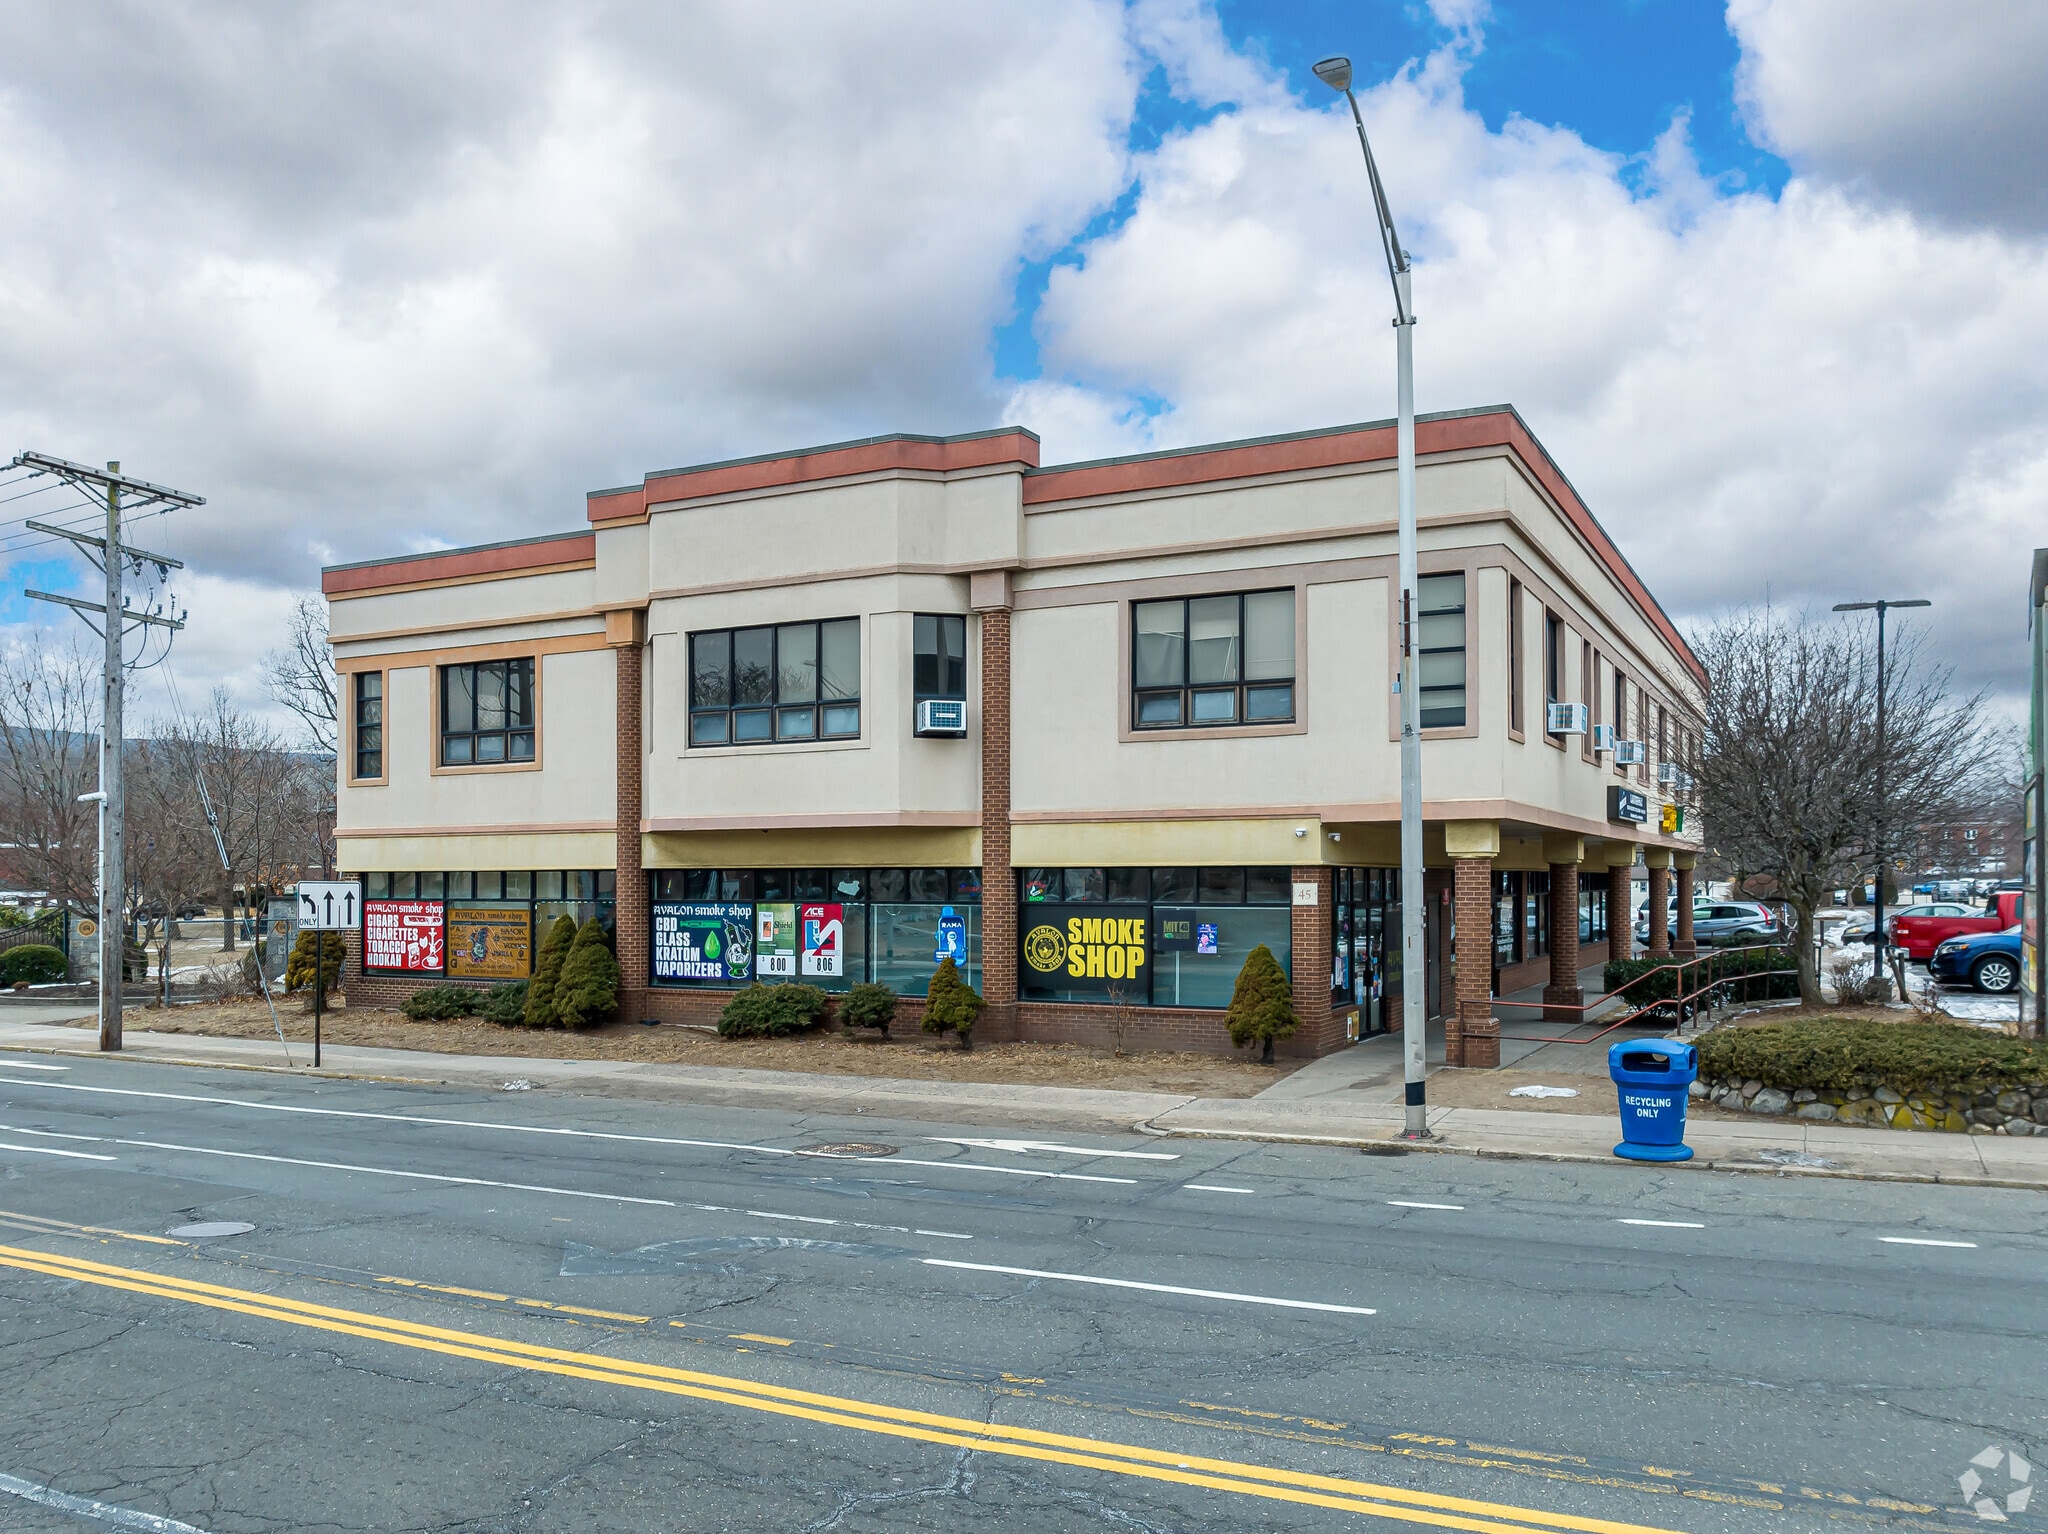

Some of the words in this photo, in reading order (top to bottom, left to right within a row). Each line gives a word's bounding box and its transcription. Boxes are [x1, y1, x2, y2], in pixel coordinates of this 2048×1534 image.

[1297, 889, 1311, 900] 45
[366, 904, 398, 913] AVALON
[398, 902, 423, 913] smoke
[425, 902, 444, 917] shop
[455, 911, 485, 920] AVALON
[653, 905, 693, 915] AVALON
[694, 903, 726, 916] smoke
[728, 903, 752, 920] shop
[804, 907, 824, 915] ACE
[300, 918, 317, 926] ONLY
[367, 914, 399, 927] CIGARS
[655, 917, 678, 932] CBD
[774, 920, 793, 929] Shield
[1163, 920, 1179, 933] MIT
[367, 927, 419, 941] CIGARETTES
[1031, 928, 1060, 940] AVALON
[1067, 917, 1145, 945] SMOKE
[655, 931, 691, 947] GLASS
[367, 940, 406, 954] TOBACCO
[655, 946, 700, 961] KRATOM
[367, 952, 402, 967] HOOKAH
[770, 957, 786, 972] 8.00
[816, 957, 833, 973] 8.06
[1067, 944, 1145, 979] SHOP
[655, 961, 722, 977] VAPORIZERS
[1625, 1095, 1671, 1108] RECYCLING
[1636, 1108, 1659, 1118] ONLY
